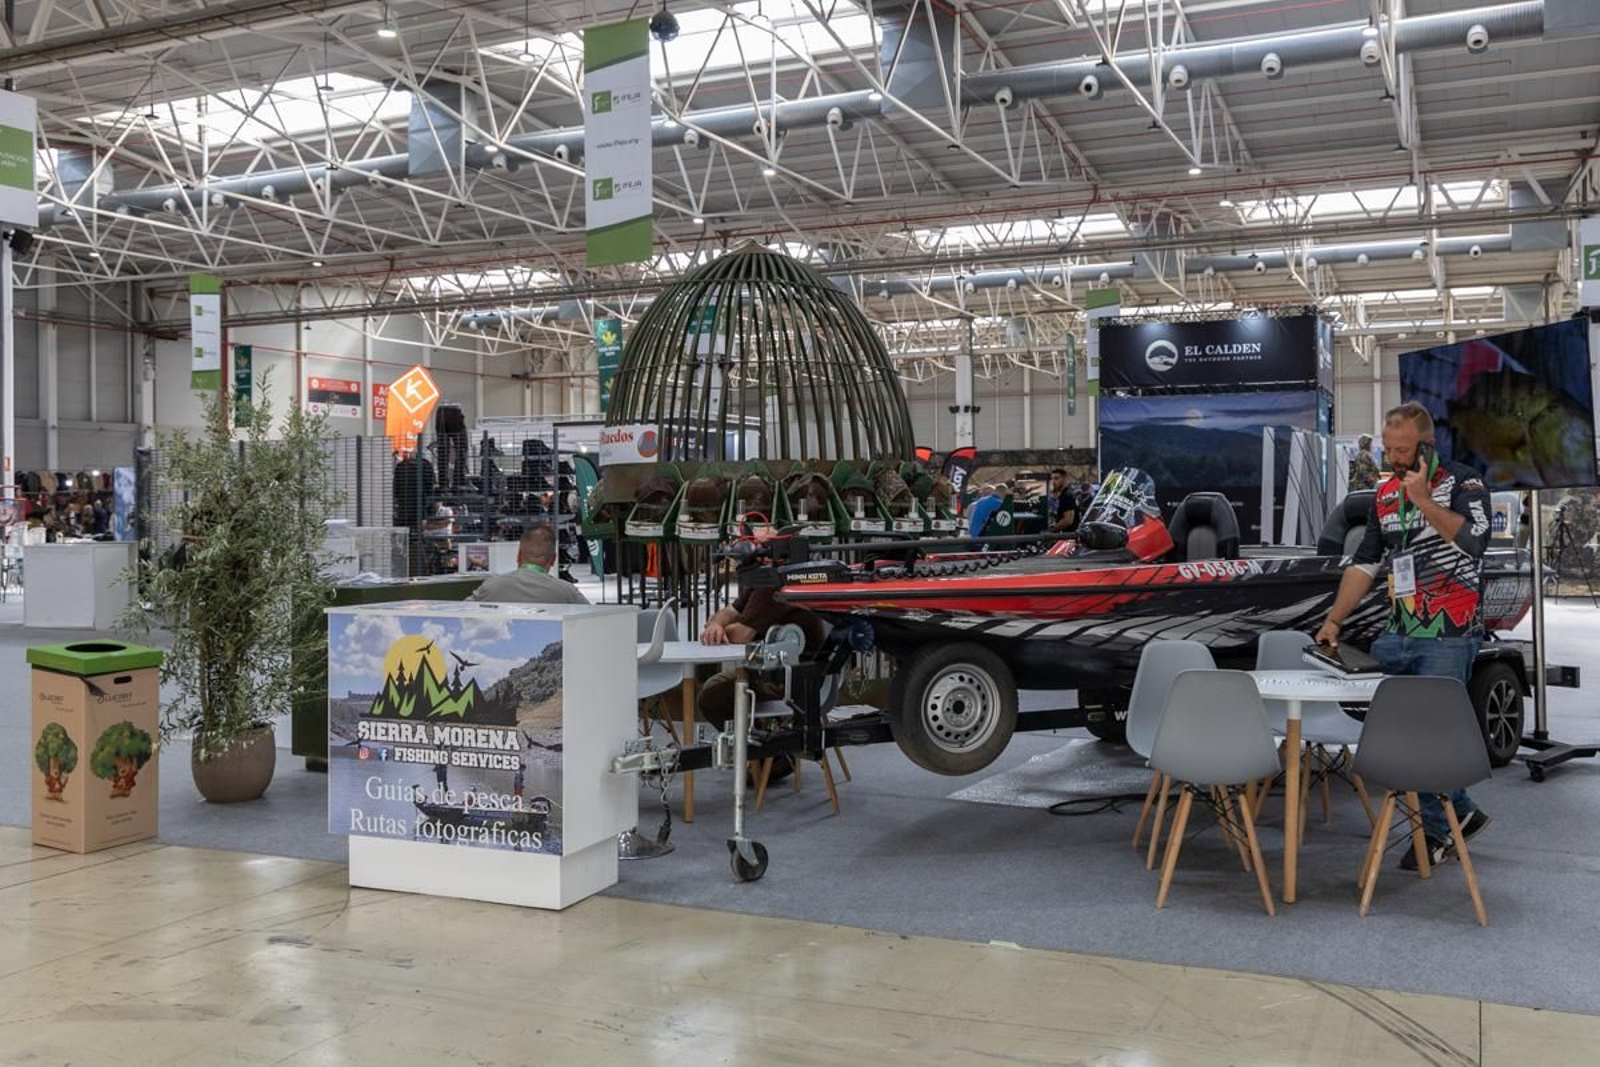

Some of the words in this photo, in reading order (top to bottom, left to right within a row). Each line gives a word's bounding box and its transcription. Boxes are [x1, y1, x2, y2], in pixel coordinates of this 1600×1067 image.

[1184, 345, 1202, 356] EL
[1205, 342, 1261, 355] CALDEN
[787, 573, 807, 581] MINN
[808, 572, 828, 580] KOTA
[357, 720, 429, 745] SIERRA
[433, 725, 520, 750] MORENA
[393, 746, 449, 765] FISHING
[451, 751, 521, 771] SERVICES
[365, 775, 427, 804] Guías
[432, 781, 457, 806] de
[463, 789, 524, 813] pesca
[350, 808, 407, 836] Rutas
[415, 820, 542, 848] fotográficas
